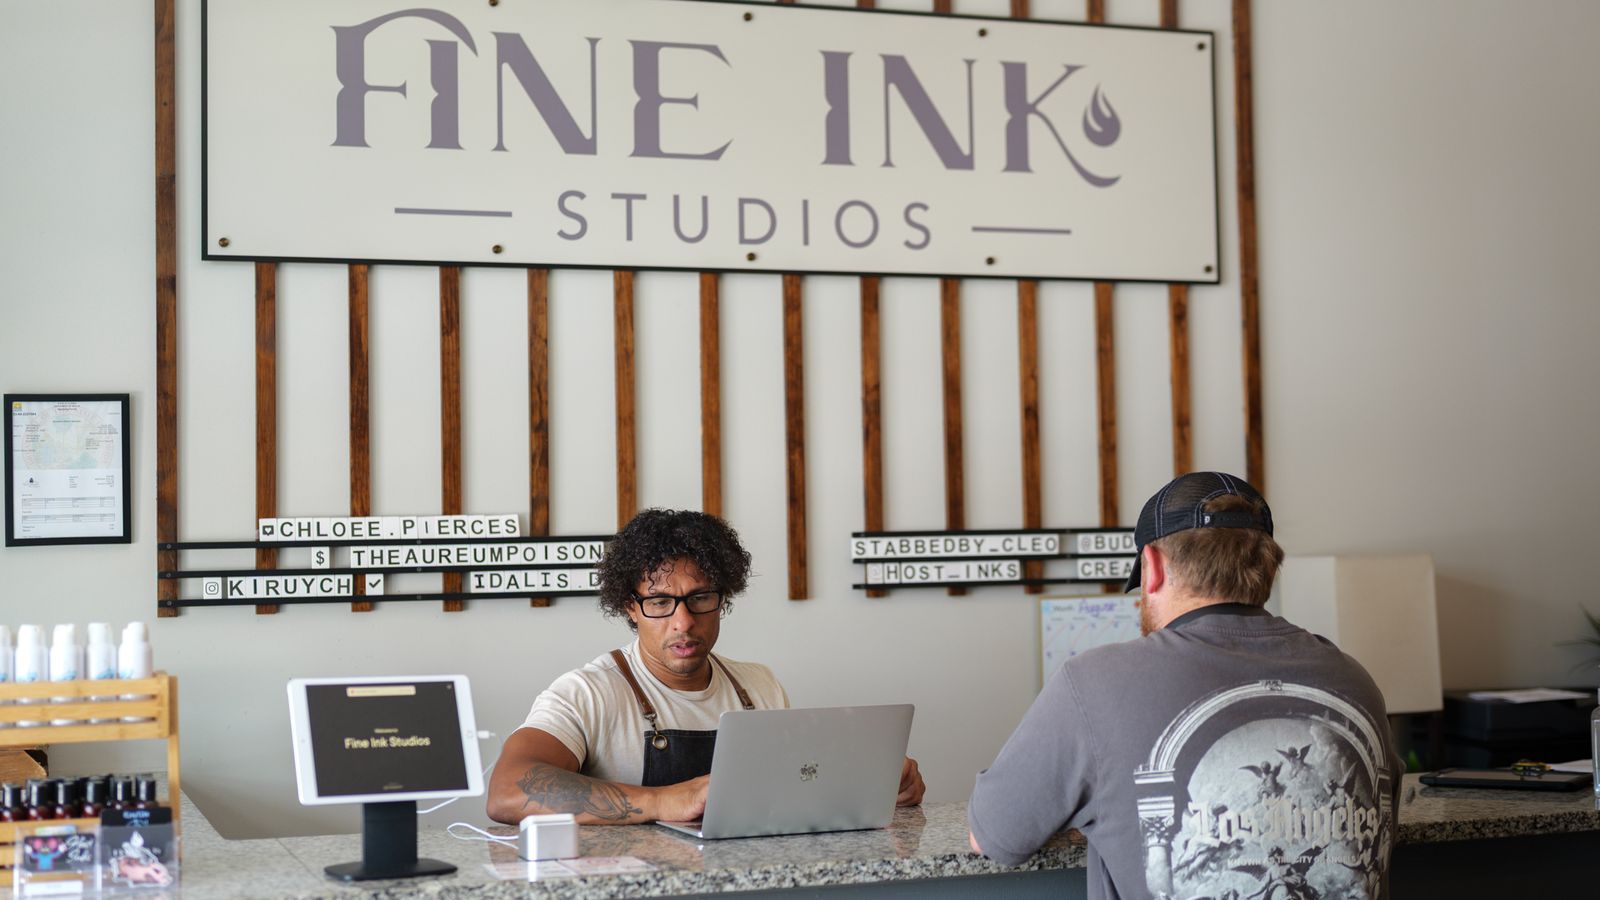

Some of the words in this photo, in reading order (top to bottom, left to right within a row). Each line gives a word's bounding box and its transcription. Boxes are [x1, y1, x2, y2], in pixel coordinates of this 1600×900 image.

[329, 8, 734, 161] FINE
[818, 50, 1121, 188] INK
[557, 190, 931, 250] STUDIOS
[279, 519, 518, 538] CHLOEE.PIERCES
[352, 544, 602, 567] THEAUREUMPOISON
[855, 536, 1058, 557] STABBEDBY_CLEO
[1080, 560, 1132, 577] CREA
[228, 577, 352, 597] KIRUYCH
[344, 737, 370, 749] Fine
[370, 736, 389, 748] Ink
[389, 735, 431, 748] Studios
[1188, 800, 1260, 848] Los
[1261, 793, 1381, 850] Angeles
[1296, 854, 1313, 864] CITY
